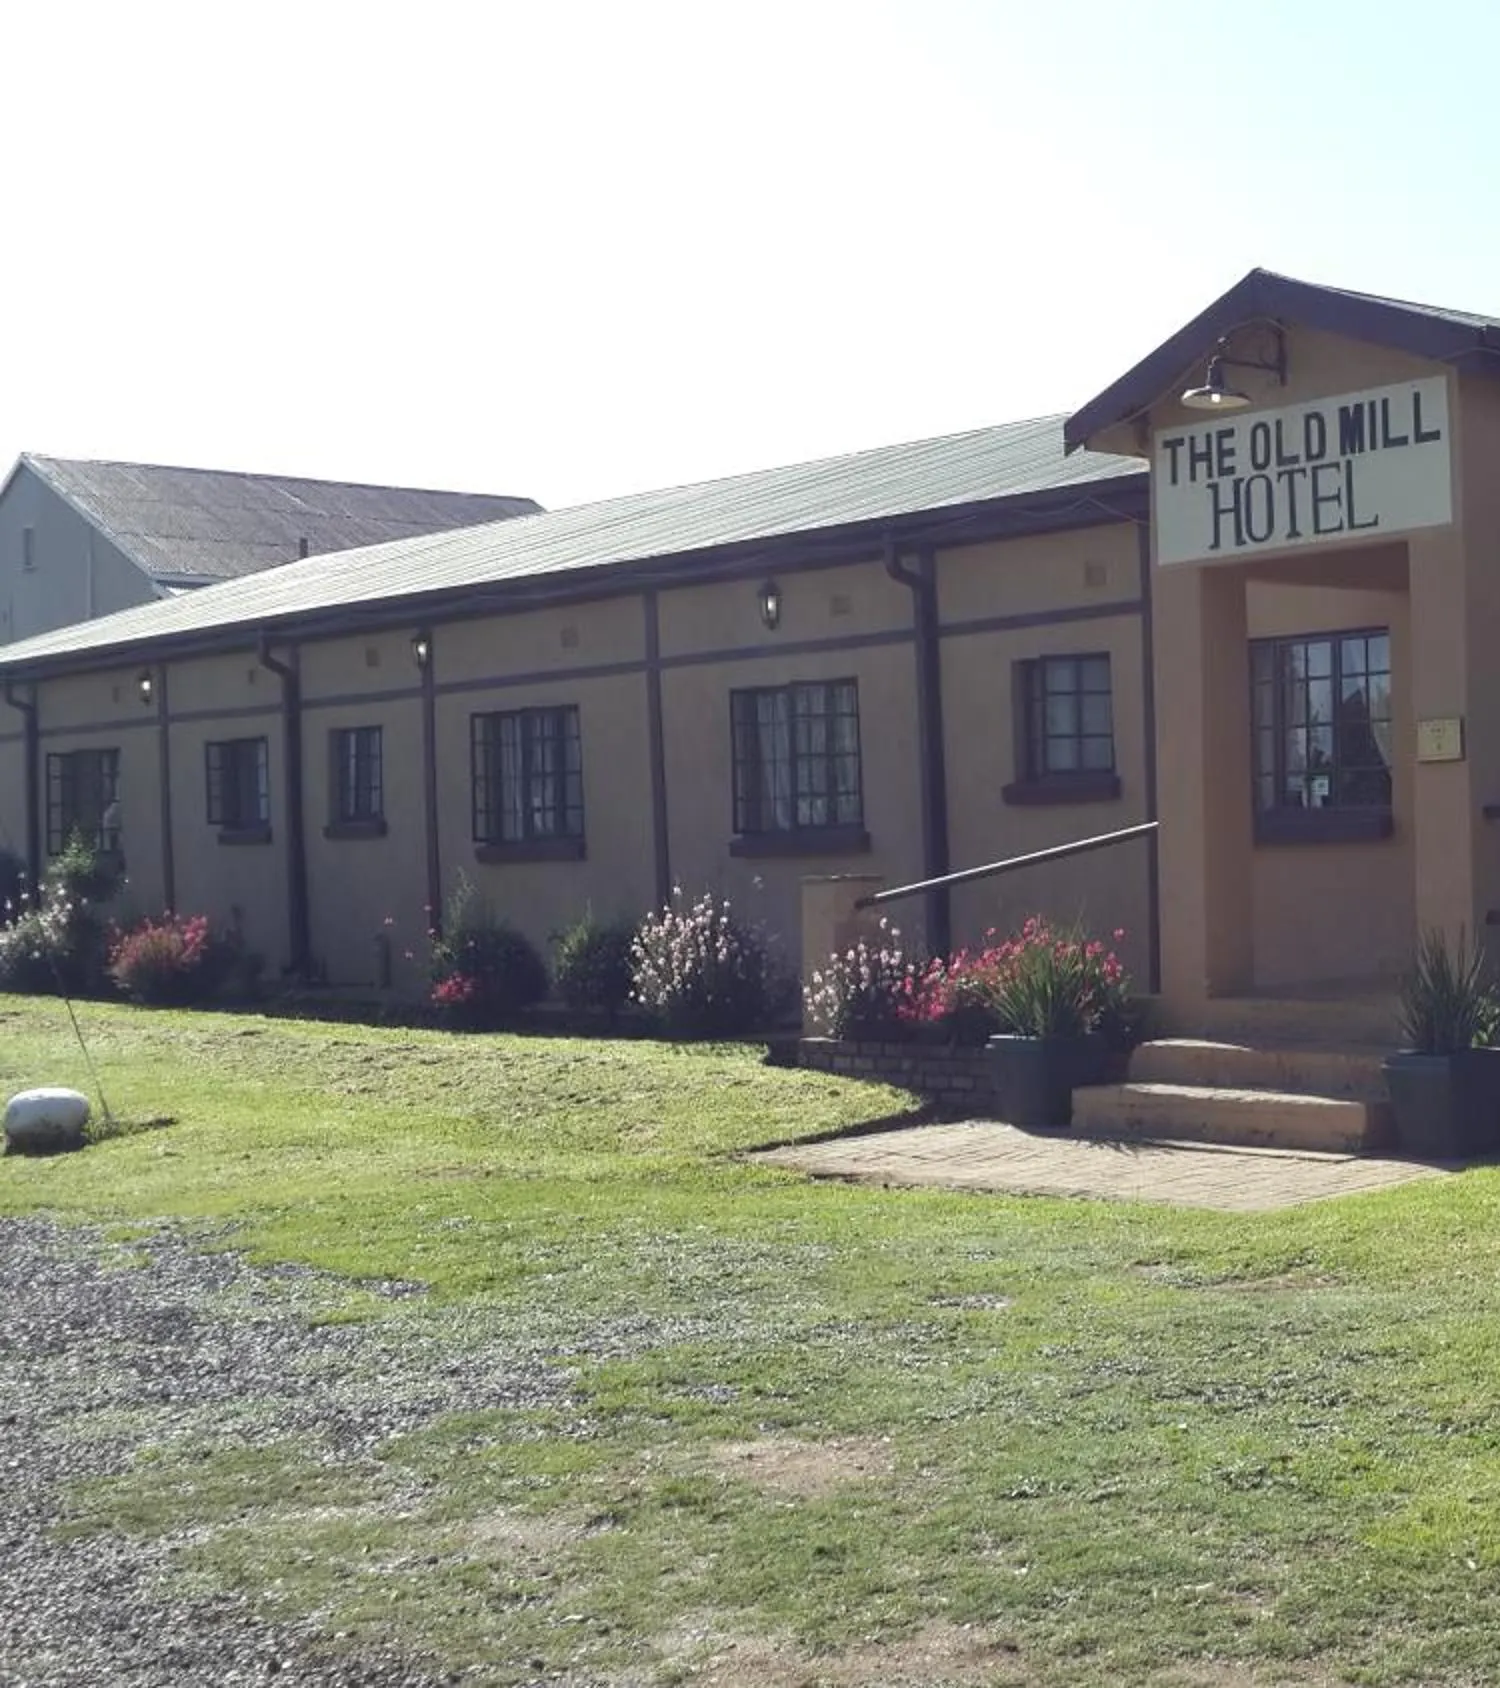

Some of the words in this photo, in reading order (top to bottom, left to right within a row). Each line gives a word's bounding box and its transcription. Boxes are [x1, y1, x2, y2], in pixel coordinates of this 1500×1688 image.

[1163, 427, 1236, 485] THE
[1251, 412, 1326, 471] OLD
[1339, 391, 1441, 456] MILL
[1206, 459, 1379, 549] HOTEL
